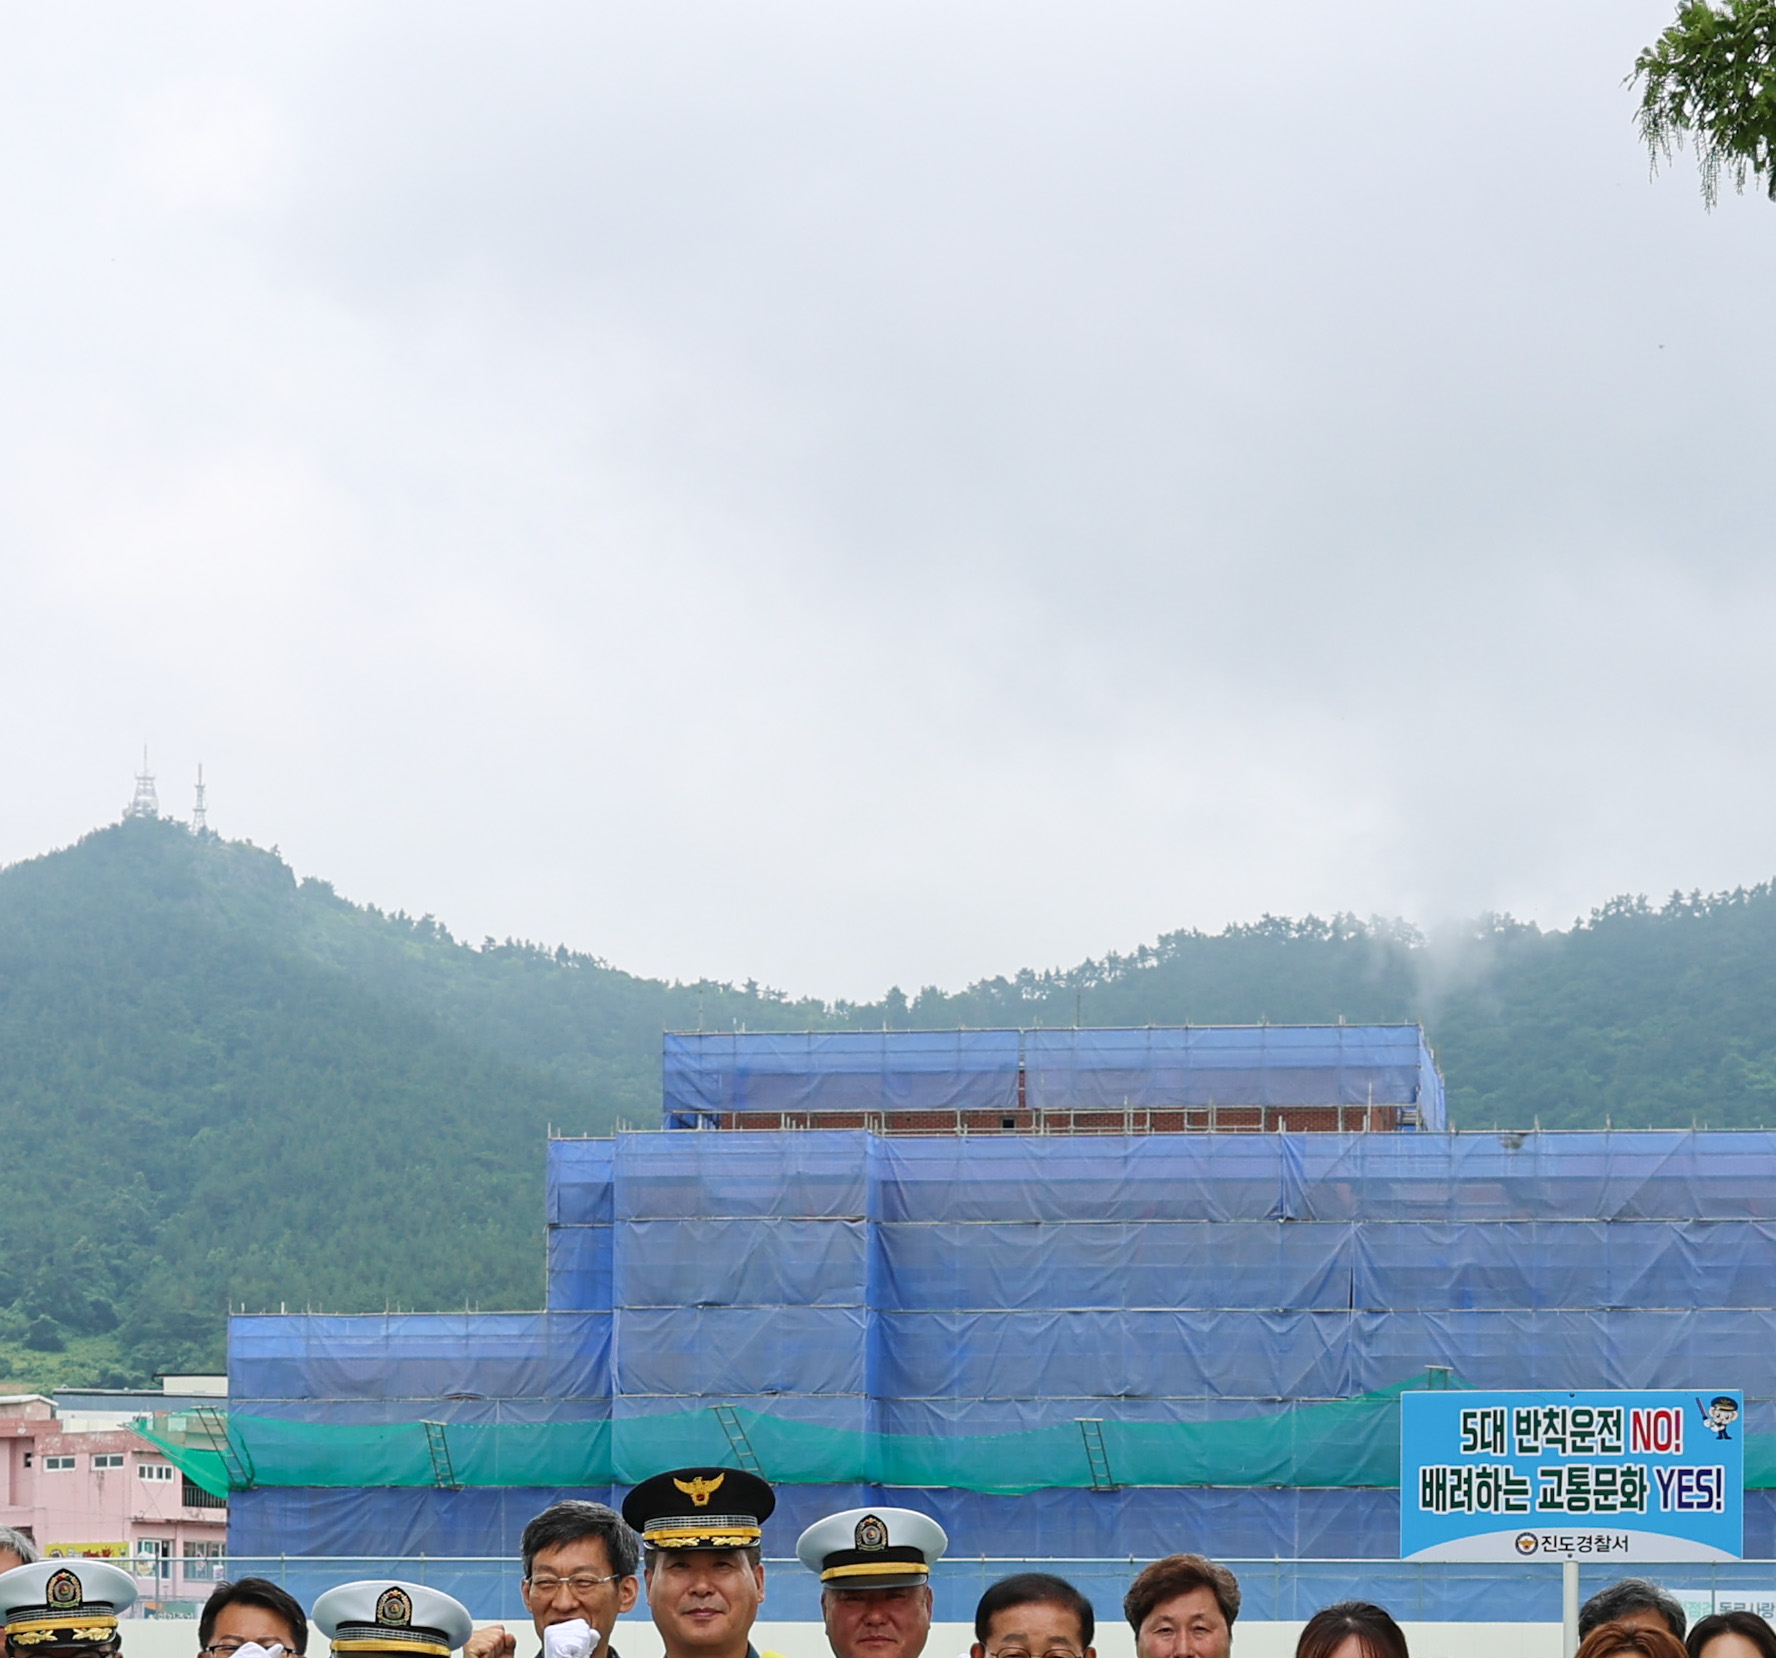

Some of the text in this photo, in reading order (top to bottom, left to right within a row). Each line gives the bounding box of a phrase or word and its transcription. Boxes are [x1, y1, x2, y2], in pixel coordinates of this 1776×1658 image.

[1461, 1408, 1682, 1455] 5대 반칙운전 NO!
[1421, 1466, 1723, 1512] 배려하는 교통문화 YES!
[1541, 1535, 1629, 1553] 진도경찰서
